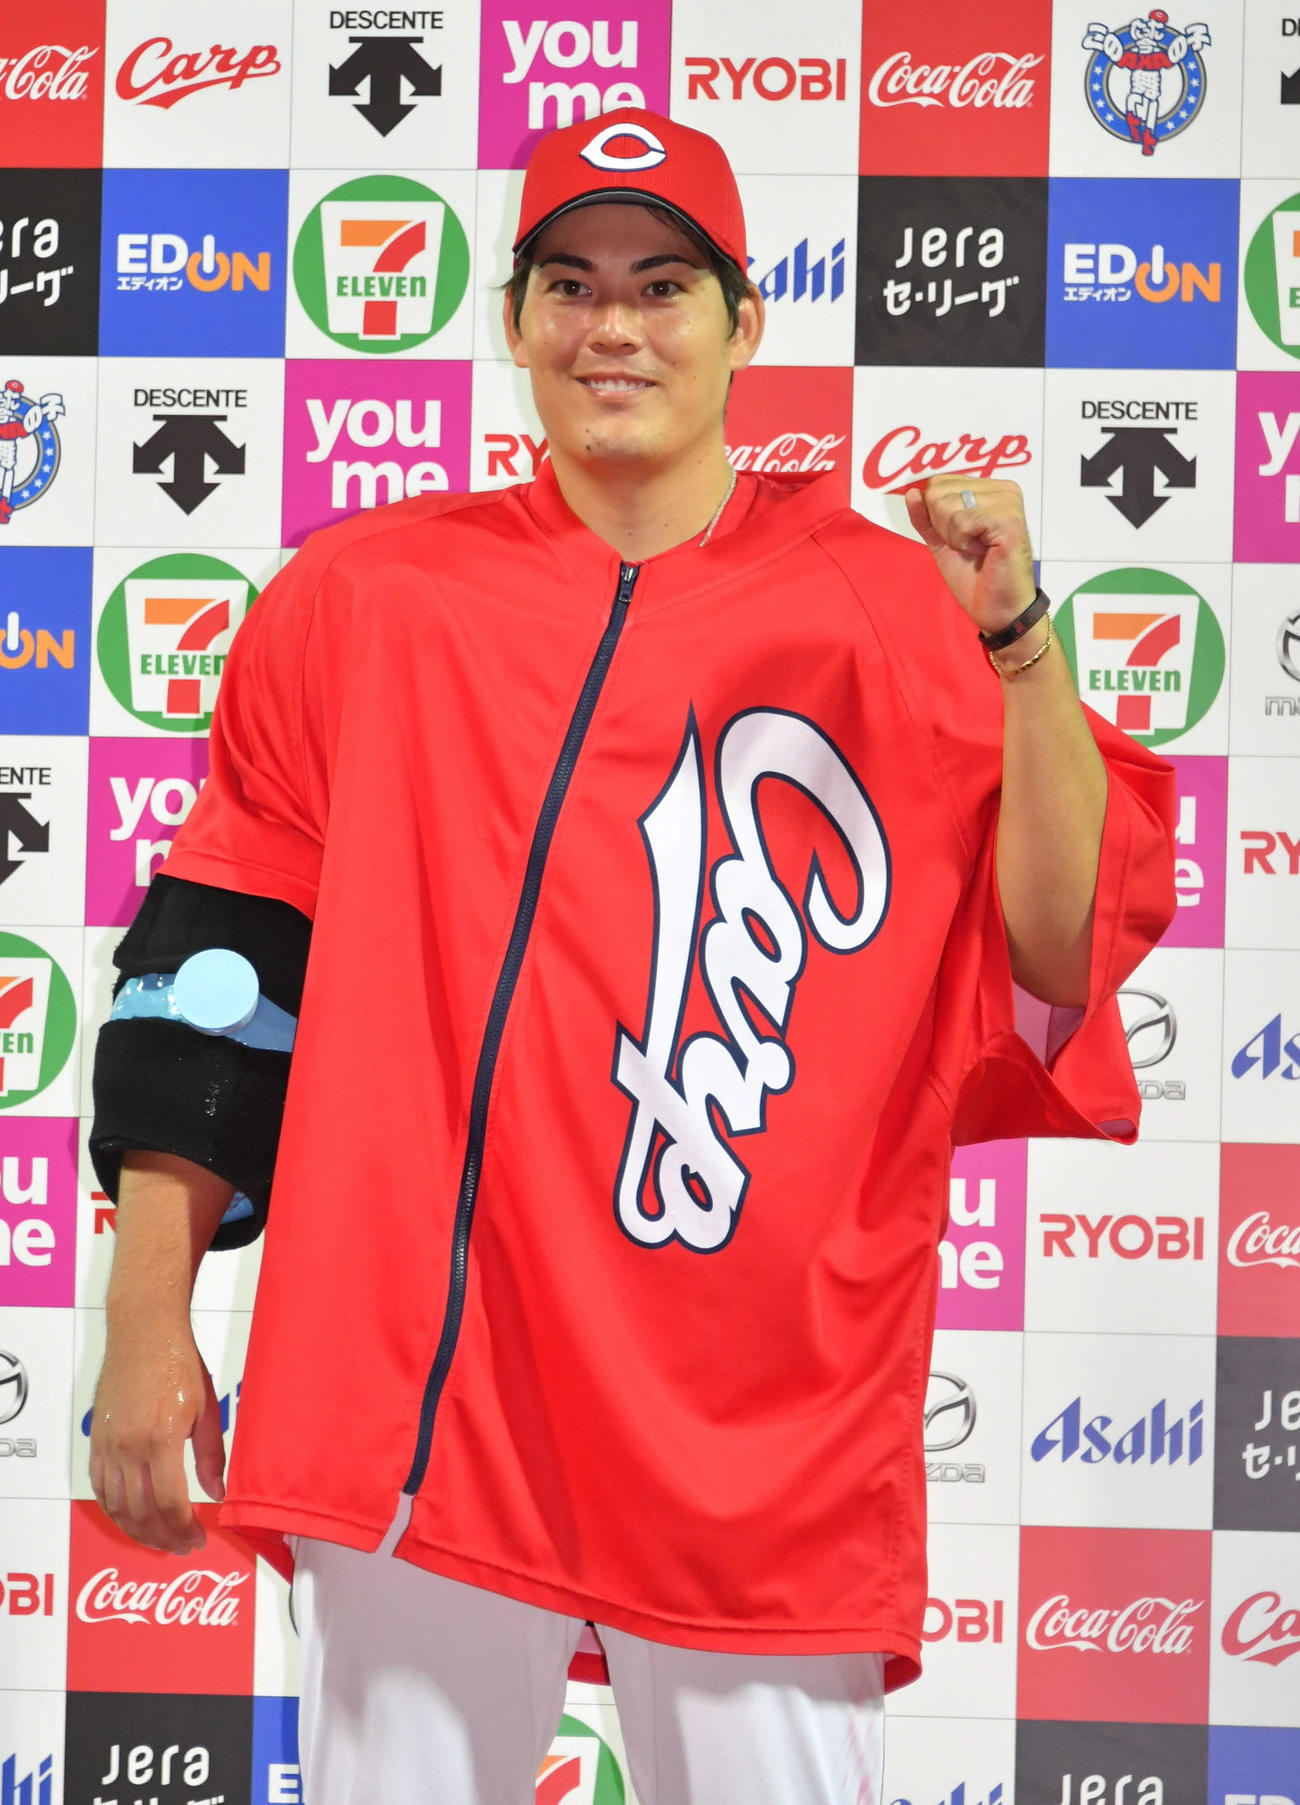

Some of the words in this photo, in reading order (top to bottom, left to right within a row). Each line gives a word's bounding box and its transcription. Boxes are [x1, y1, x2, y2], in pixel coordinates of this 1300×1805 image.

[330, 11, 444, 29] DESCENTE
[115, 36, 282, 110] Carp
[502, 19, 638, 84] you
[684, 57, 846, 101] RYOBI
[868, 51, 1045, 109] Coca-Cola
[0, 217, 59, 258] ra
[116, 276, 183, 292] エディオン
[747, 237, 845, 303] ahi
[1063, 287, 1131, 303] エディオン
[133, 388, 247, 409] DESCENTE
[1081, 400, 1198, 421] DESCENTE
[306, 399, 442, 463] you
[861, 425, 1032, 496] Carp
[110, 777, 206, 841] yo
[613, 700, 893, 1255] Carp
[1040, 1214, 1204, 1261] RYOBI
[1030, 1396, 1204, 1466] Asahi
[0, 1573, 54, 1616] BI
[76, 1567, 250, 1627] Coca-Cola
[1026, 1594, 1205, 1654] Coca-Cola
